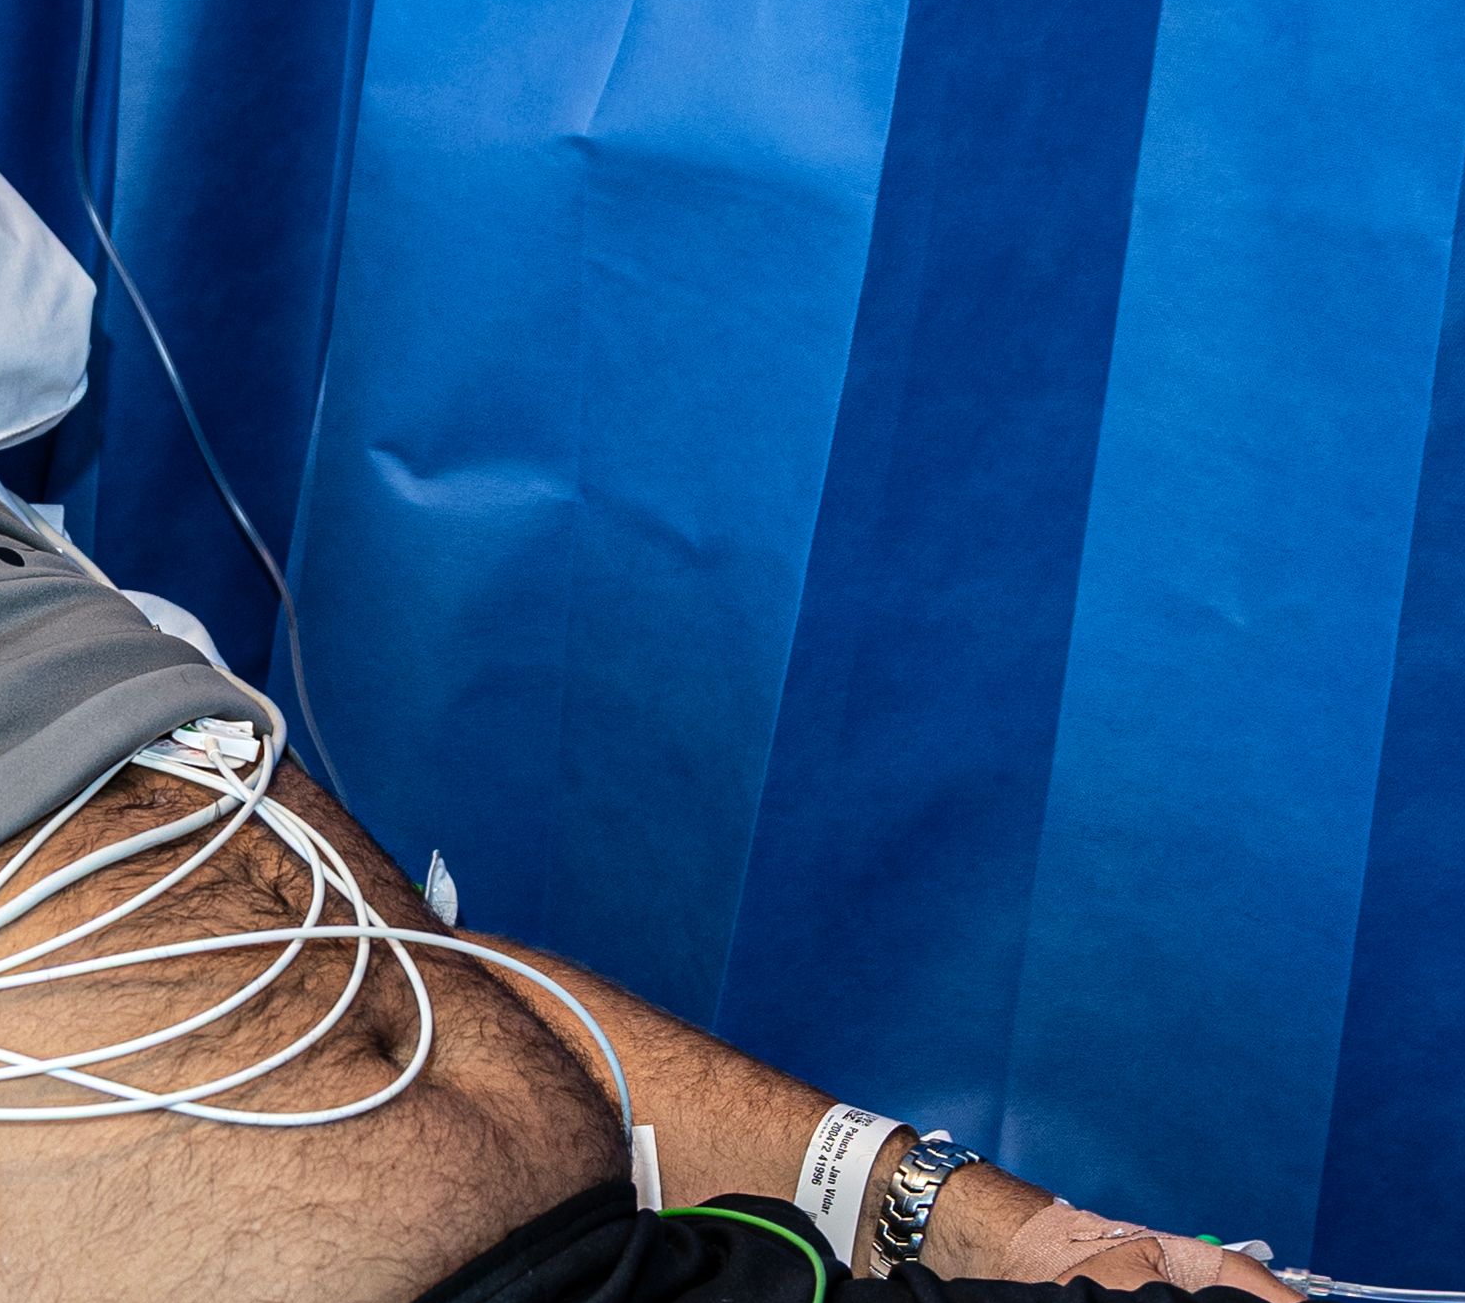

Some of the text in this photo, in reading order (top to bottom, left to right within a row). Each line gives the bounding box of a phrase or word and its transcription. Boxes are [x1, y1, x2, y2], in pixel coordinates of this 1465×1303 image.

[811, 1154, 828, 1186] 41996
[827, 1165, 841, 1185] Jan
[821, 1188, 836, 1216] Vidar
